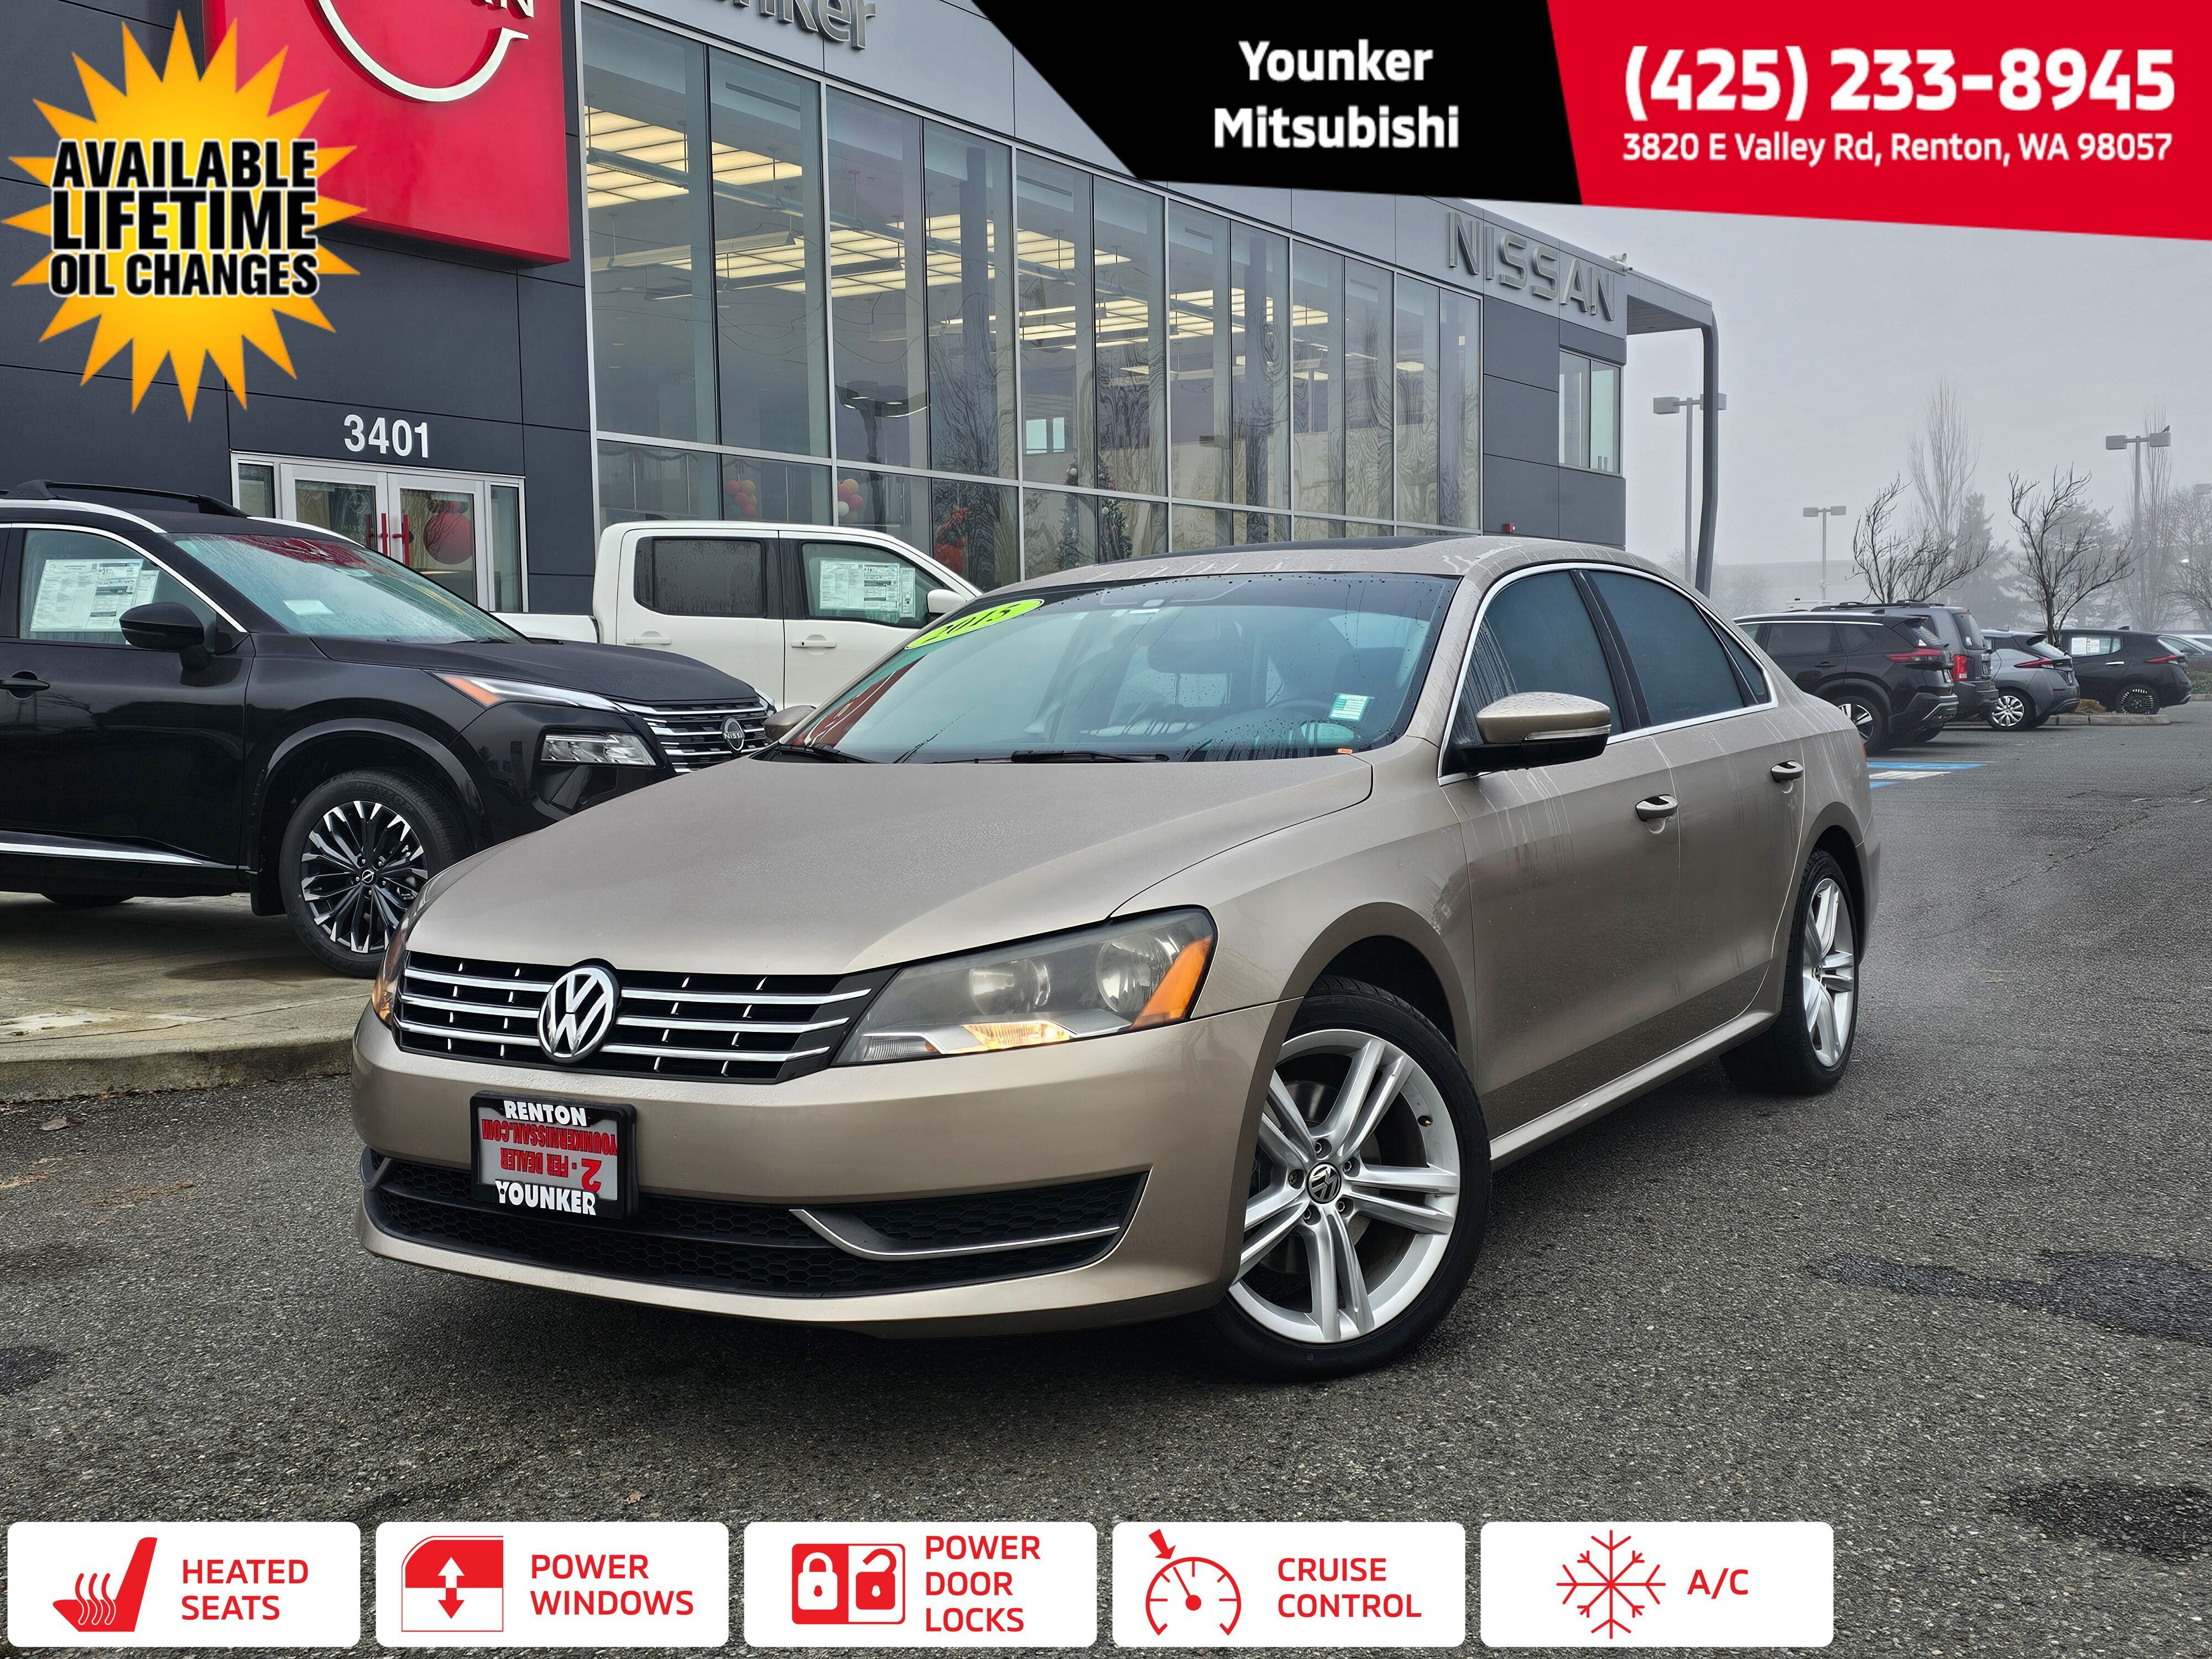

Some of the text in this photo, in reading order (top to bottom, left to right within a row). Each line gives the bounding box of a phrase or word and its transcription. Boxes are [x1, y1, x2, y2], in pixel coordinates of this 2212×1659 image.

[1449, 212, 1615, 321] NISSAN
[343, 414, 429, 458] 3401
[922, 603, 1021, 643] 2015
[503, 1099, 587, 1126] RENTON
[481, 1119, 618, 1156] YOUNKERNISSAN.COM
[500, 1147, 543, 1175] DEALER
[494, 1180, 597, 1215] YOUNKER
